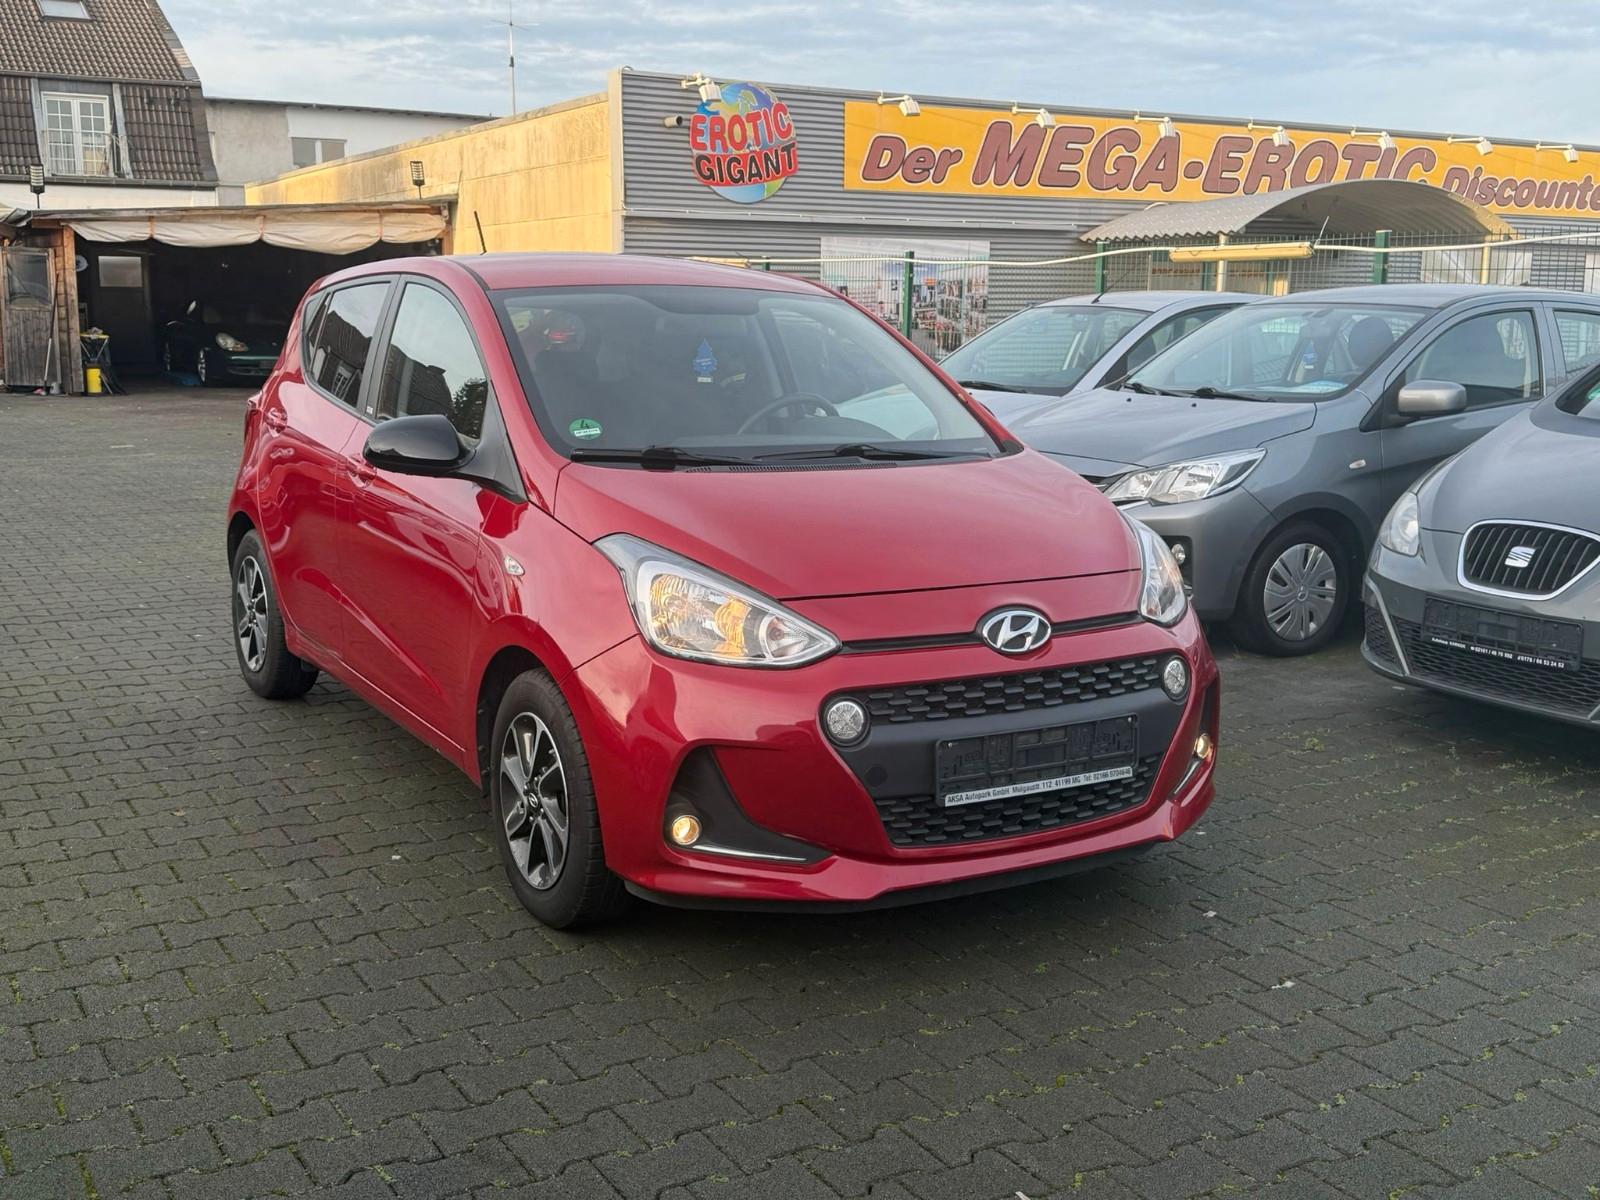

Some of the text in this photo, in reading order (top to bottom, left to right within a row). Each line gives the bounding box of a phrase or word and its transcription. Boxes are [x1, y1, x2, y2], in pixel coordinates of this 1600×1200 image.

[690, 103, 793, 151] EROTIC
[695, 142, 796, 184] GIGANT
[862, 135, 962, 184] Der
[965, 790, 992, 801] Autopark
[992, 788, 1010, 797] GmbH
